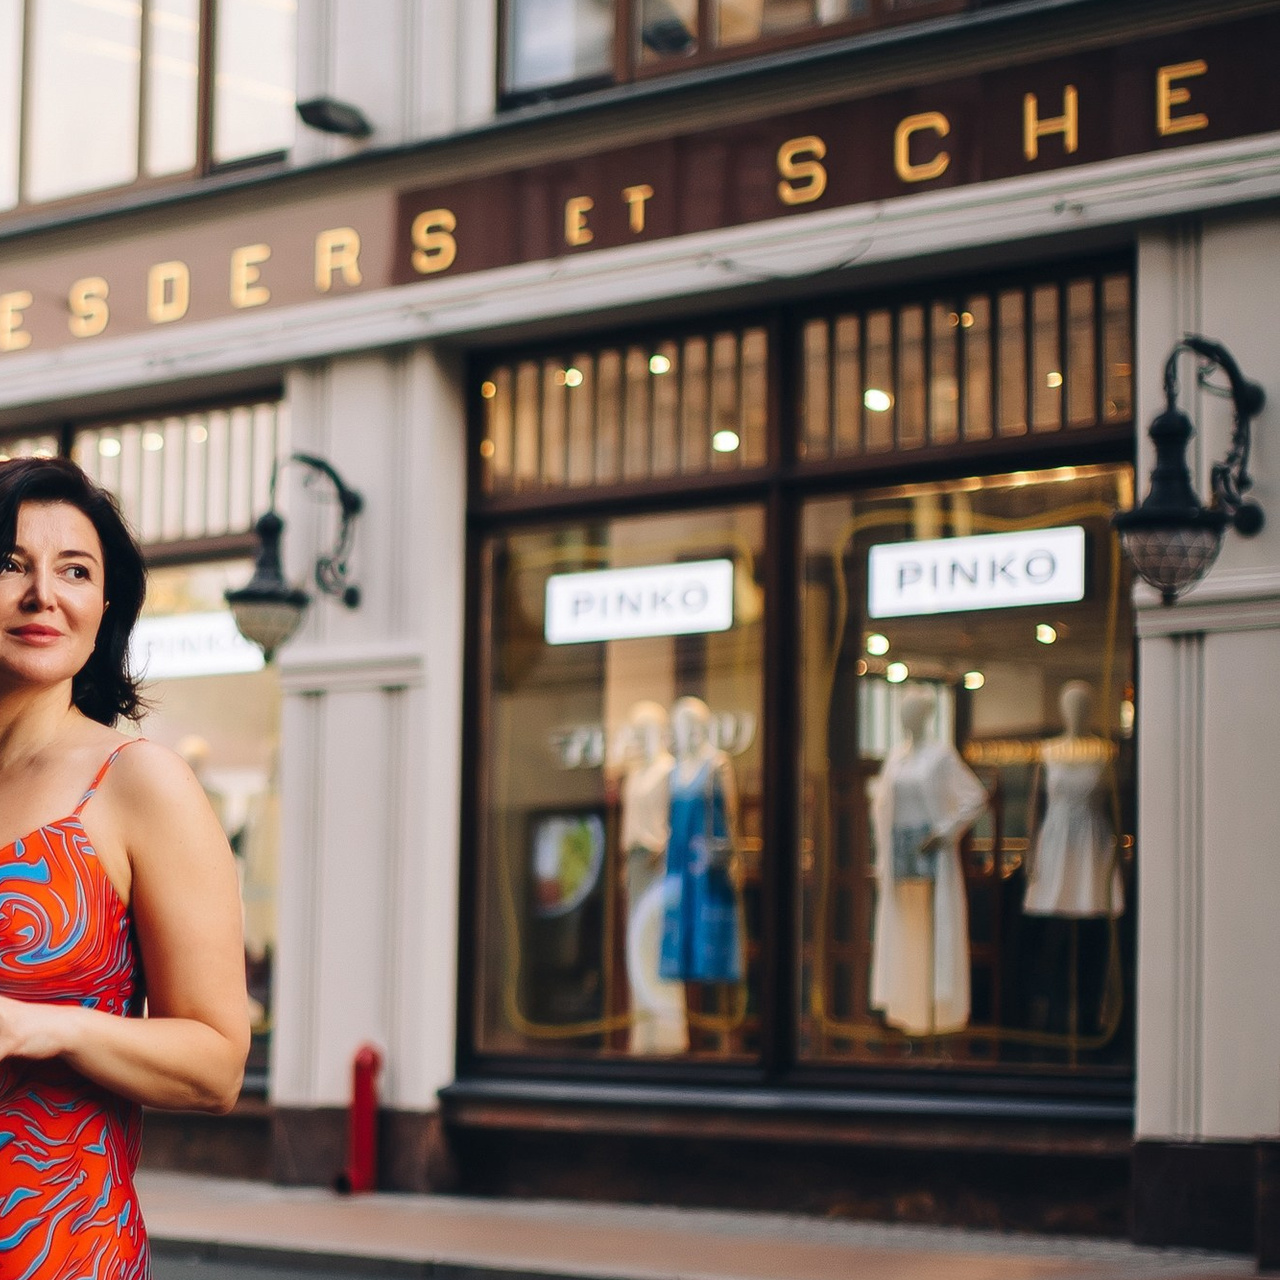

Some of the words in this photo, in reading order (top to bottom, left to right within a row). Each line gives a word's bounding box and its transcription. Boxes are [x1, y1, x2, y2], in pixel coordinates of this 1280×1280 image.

[564, 183, 654, 246] ET
[776, 59, 1209, 206] SCHE
[896, 548, 1058, 592] PINKO
[569, 582, 710, 621] PINKO
